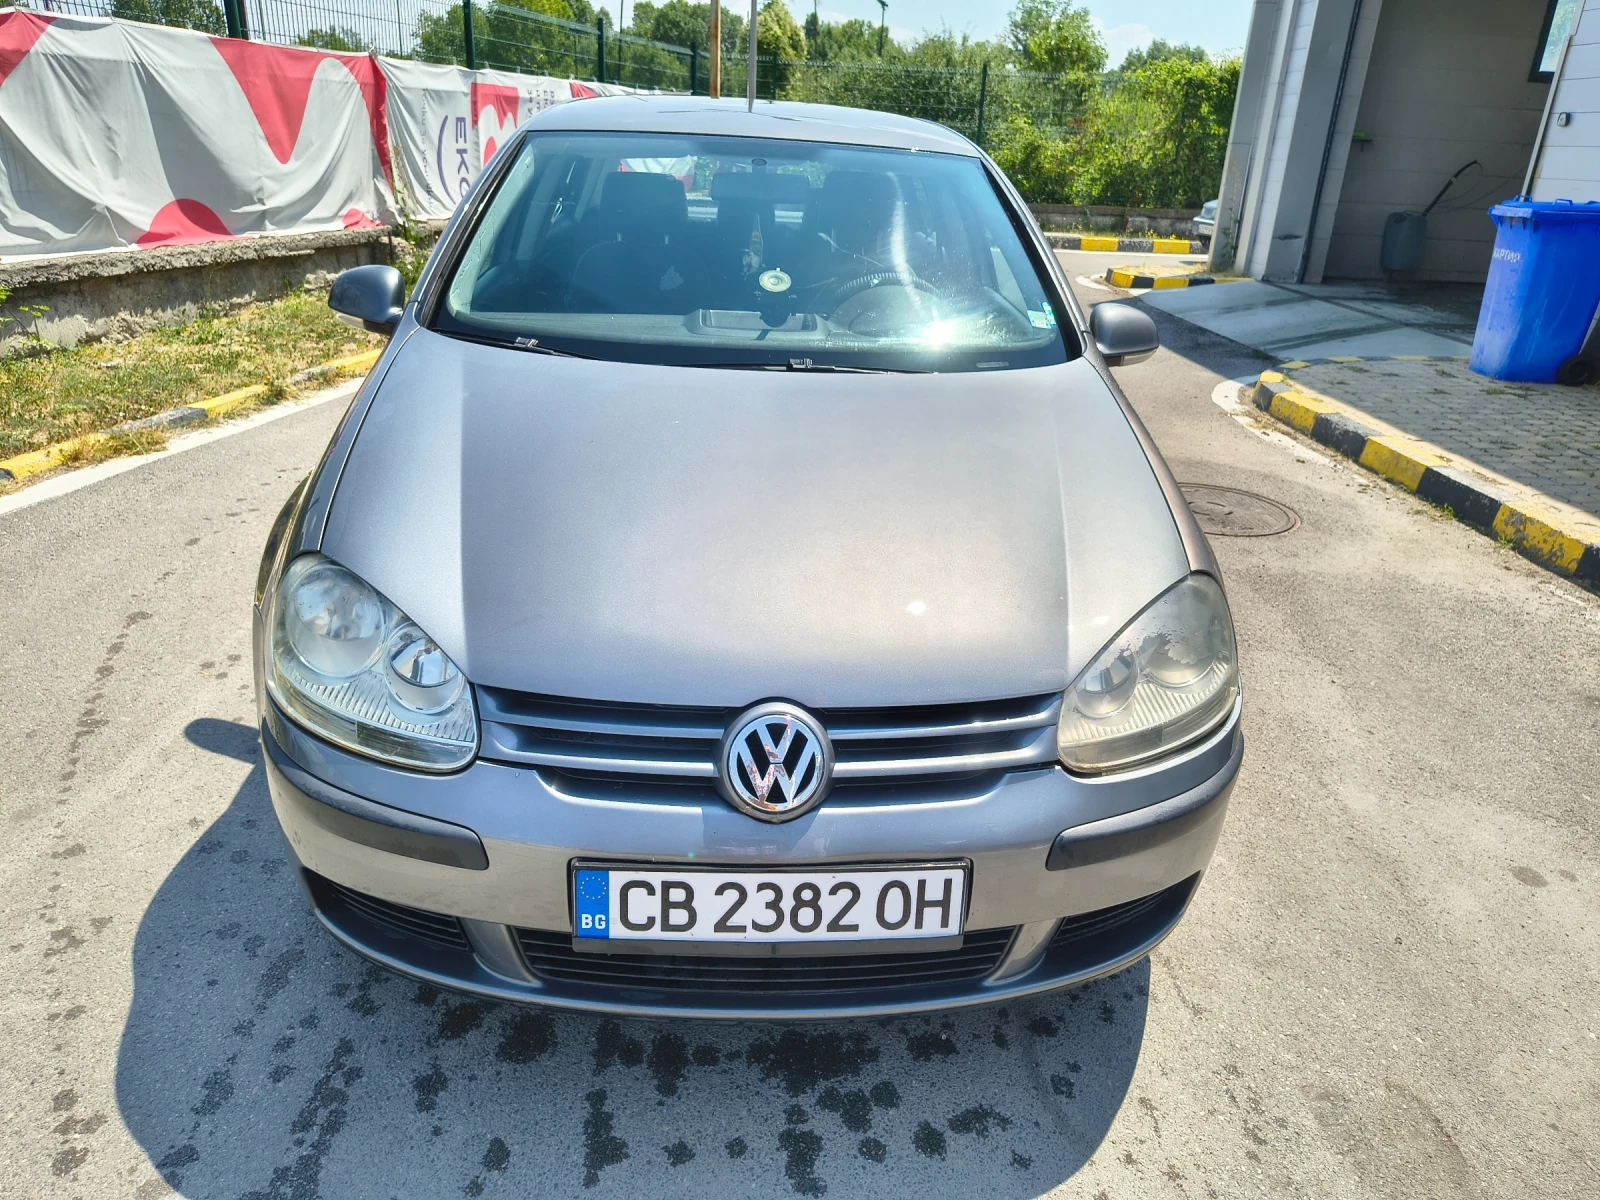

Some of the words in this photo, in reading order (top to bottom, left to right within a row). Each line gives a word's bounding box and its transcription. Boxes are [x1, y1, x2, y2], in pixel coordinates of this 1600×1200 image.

[581, 913, 606, 930] BG
[619, 879, 697, 933] CB
[713, 880, 861, 933] 2382
[876, 878, 953, 931] OH
